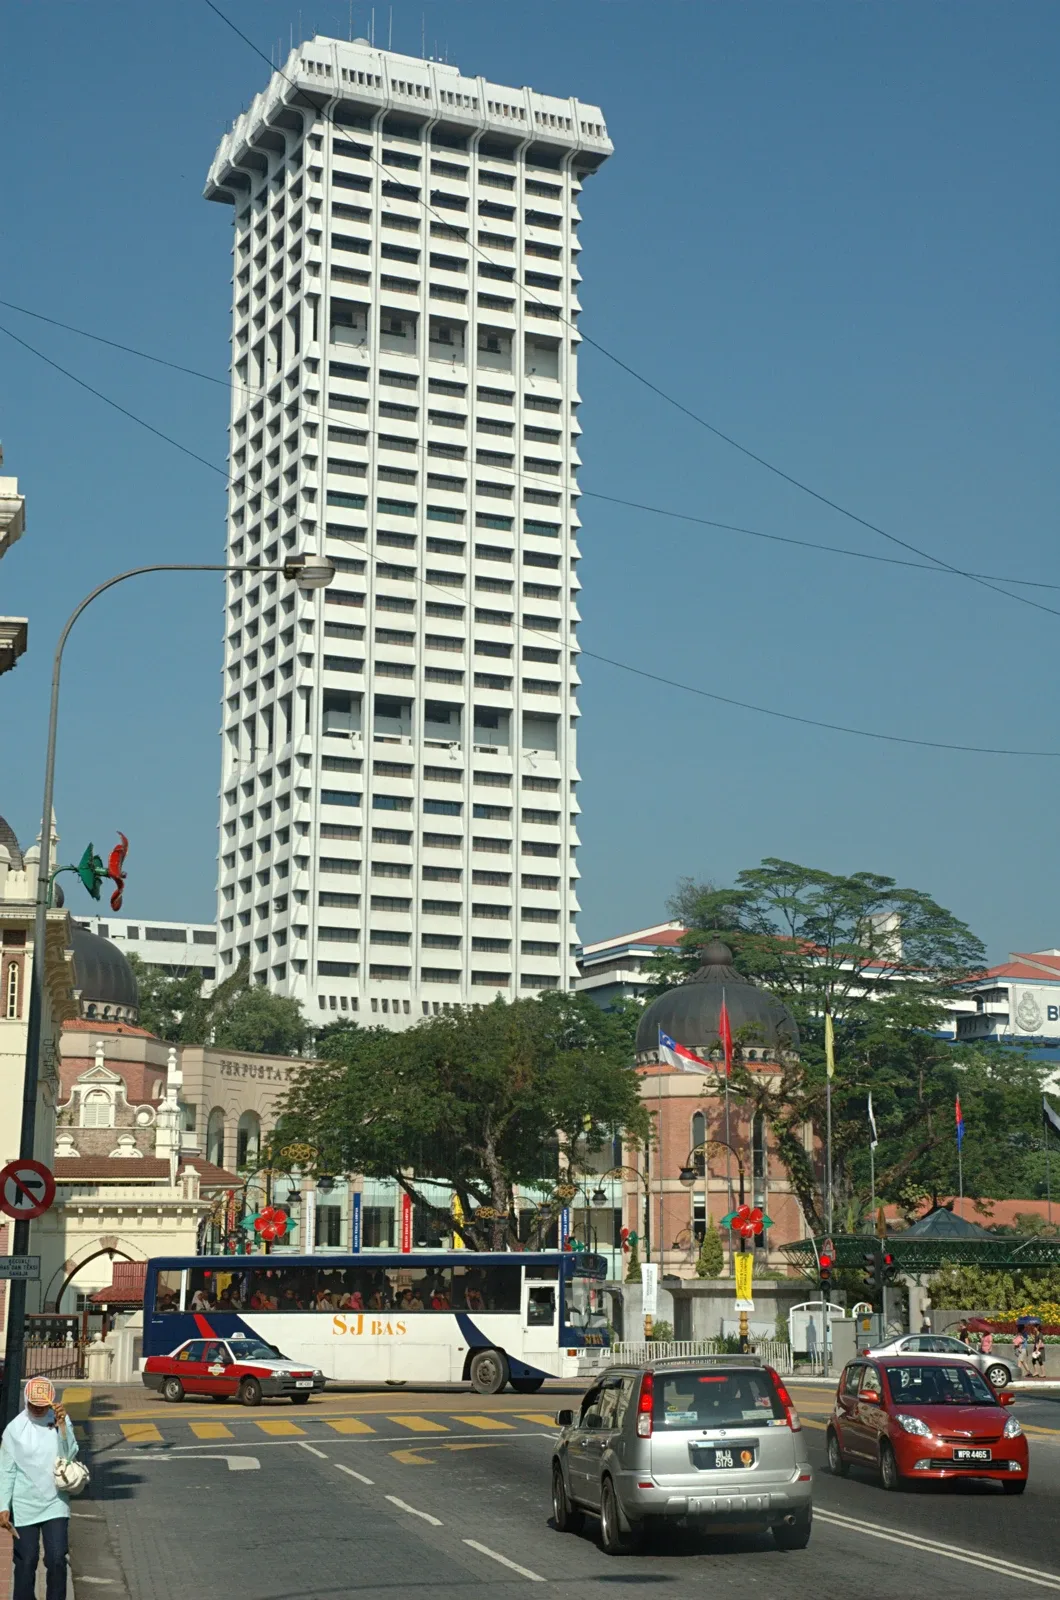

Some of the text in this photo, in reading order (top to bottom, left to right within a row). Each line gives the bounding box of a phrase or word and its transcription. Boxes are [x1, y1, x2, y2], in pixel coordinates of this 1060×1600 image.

[1047, 1005, 1060, 1021] B
[332, 1314, 407, 1336] SJ BAS
[957, 1450, 988, 1459] WPR 4465
[715, 1458, 734, 1467] 5179
